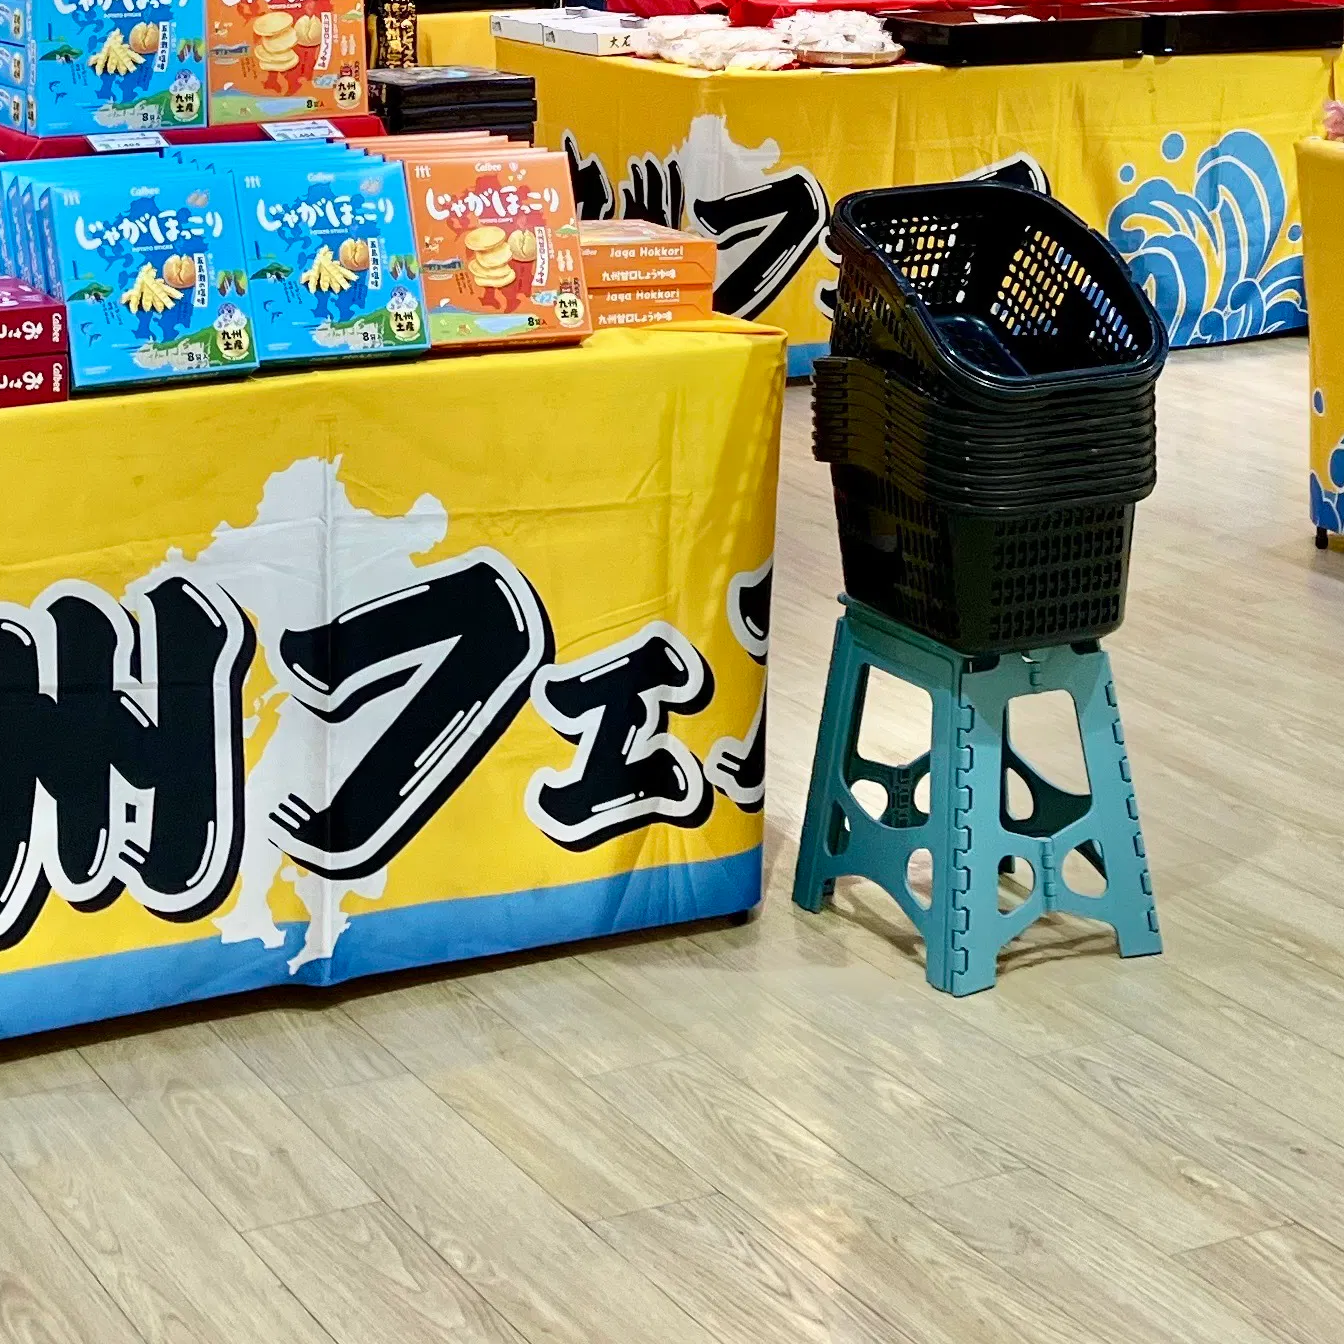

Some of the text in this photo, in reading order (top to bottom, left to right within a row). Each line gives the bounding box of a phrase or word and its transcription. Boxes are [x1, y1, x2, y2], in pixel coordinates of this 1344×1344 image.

[338, 82, 356, 92] 九州
[175, 94, 194, 103] 九州
[339, 91, 356, 101] 土産
[176, 103, 194, 113] 土産
[425, 186, 560, 221] じゃがほっこり
[256, 195, 394, 232] じゃがほっこり
[74, 210, 223, 251] じゃがほっこり
[609, 247, 635, 259] Jaga
[639, 245, 684, 258] Hokkori
[601, 269, 677, 282] 九州甘口しょうゆ味
[605, 288, 680, 303] Jaga Hokkori
[558, 298, 578, 309] 九州
[394, 311, 414, 322] 九州
[560, 308, 579, 319] 土産
[597, 311, 673, 325] 九州甘口しょうゆ味
[396, 322, 415, 332] 土産
[221, 329, 243, 340] 九州
[223, 340, 244, 351] 土産
